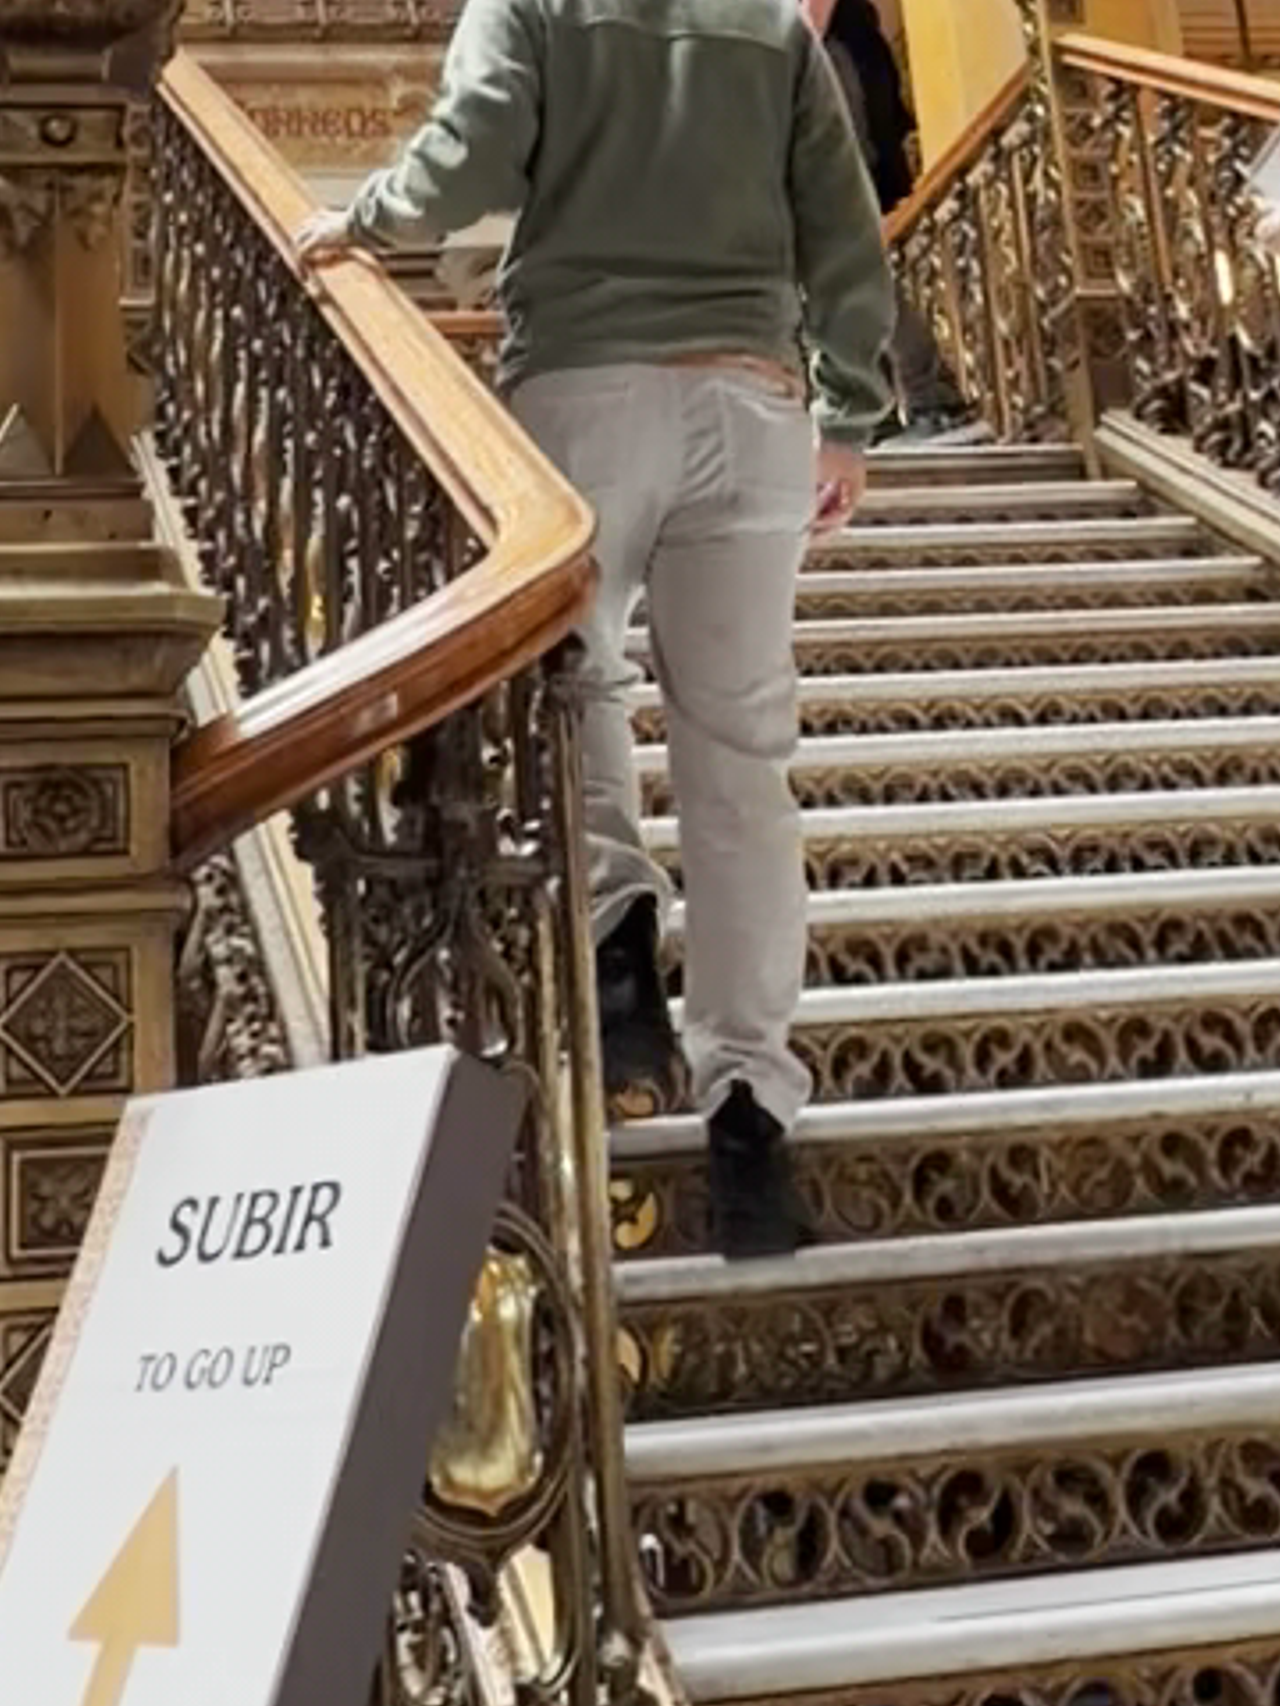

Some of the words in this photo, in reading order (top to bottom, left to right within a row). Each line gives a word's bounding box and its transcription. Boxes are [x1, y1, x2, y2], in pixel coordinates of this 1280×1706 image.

[240, 102, 393, 140] ORREOS
[156, 1180, 342, 1268] SUBIR
[135, 1351, 178, 1392] TO
[184, 1346, 234, 1390] GO
[242, 1342, 292, 1387] UP
